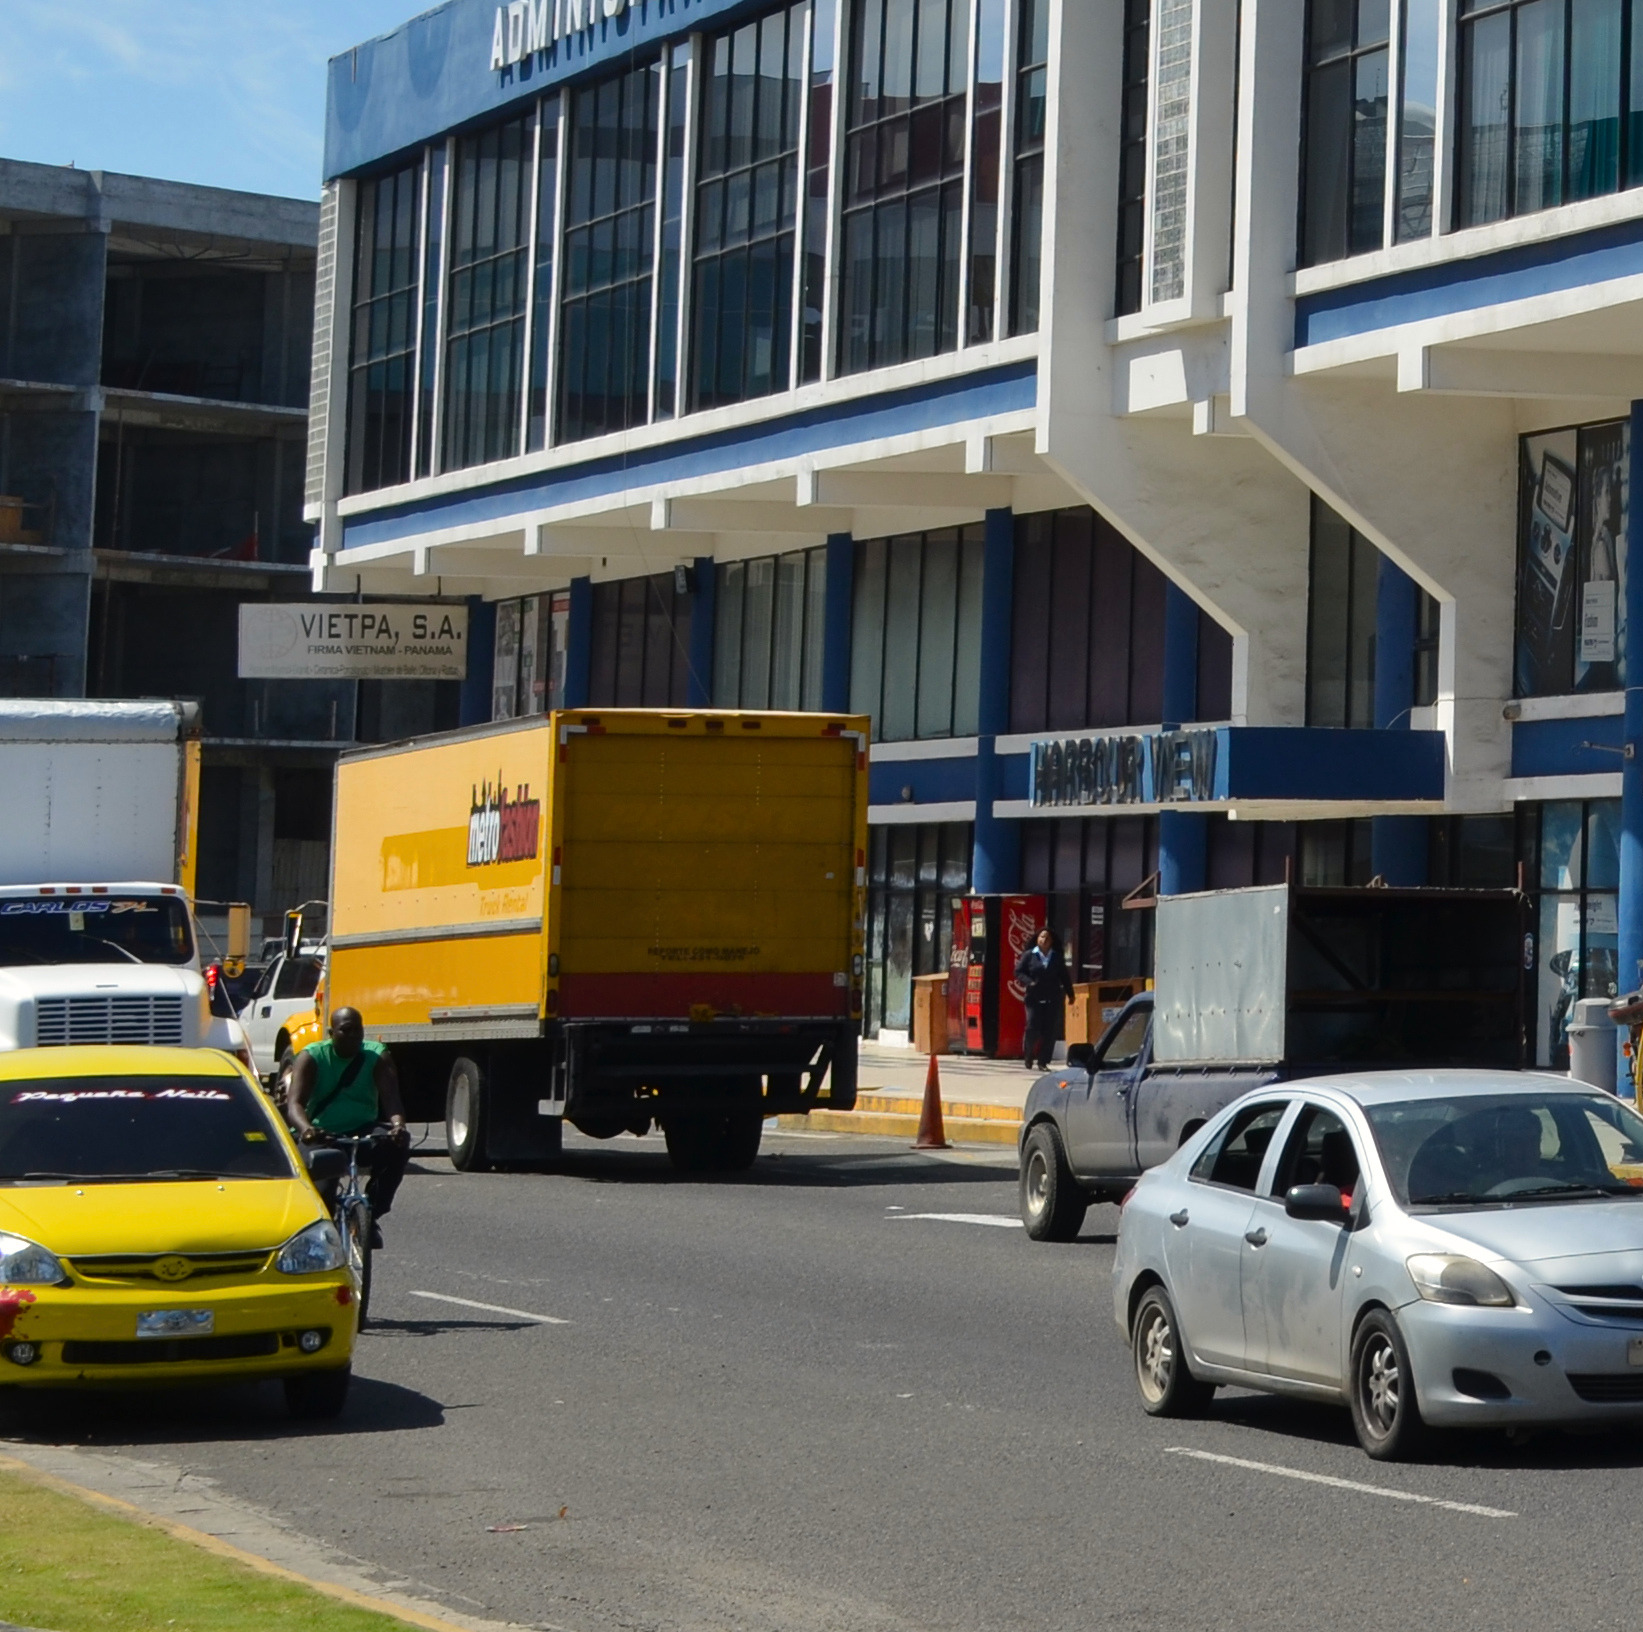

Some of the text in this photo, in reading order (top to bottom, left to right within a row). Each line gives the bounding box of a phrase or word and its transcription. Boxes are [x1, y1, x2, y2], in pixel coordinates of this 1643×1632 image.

[301, 614, 462, 645] VIETPA, S.A.
[307, 645, 343, 655] FIRMA
[344, 645, 396, 655] VIETNAM
[1, 900, 112, 915] CARLOS
